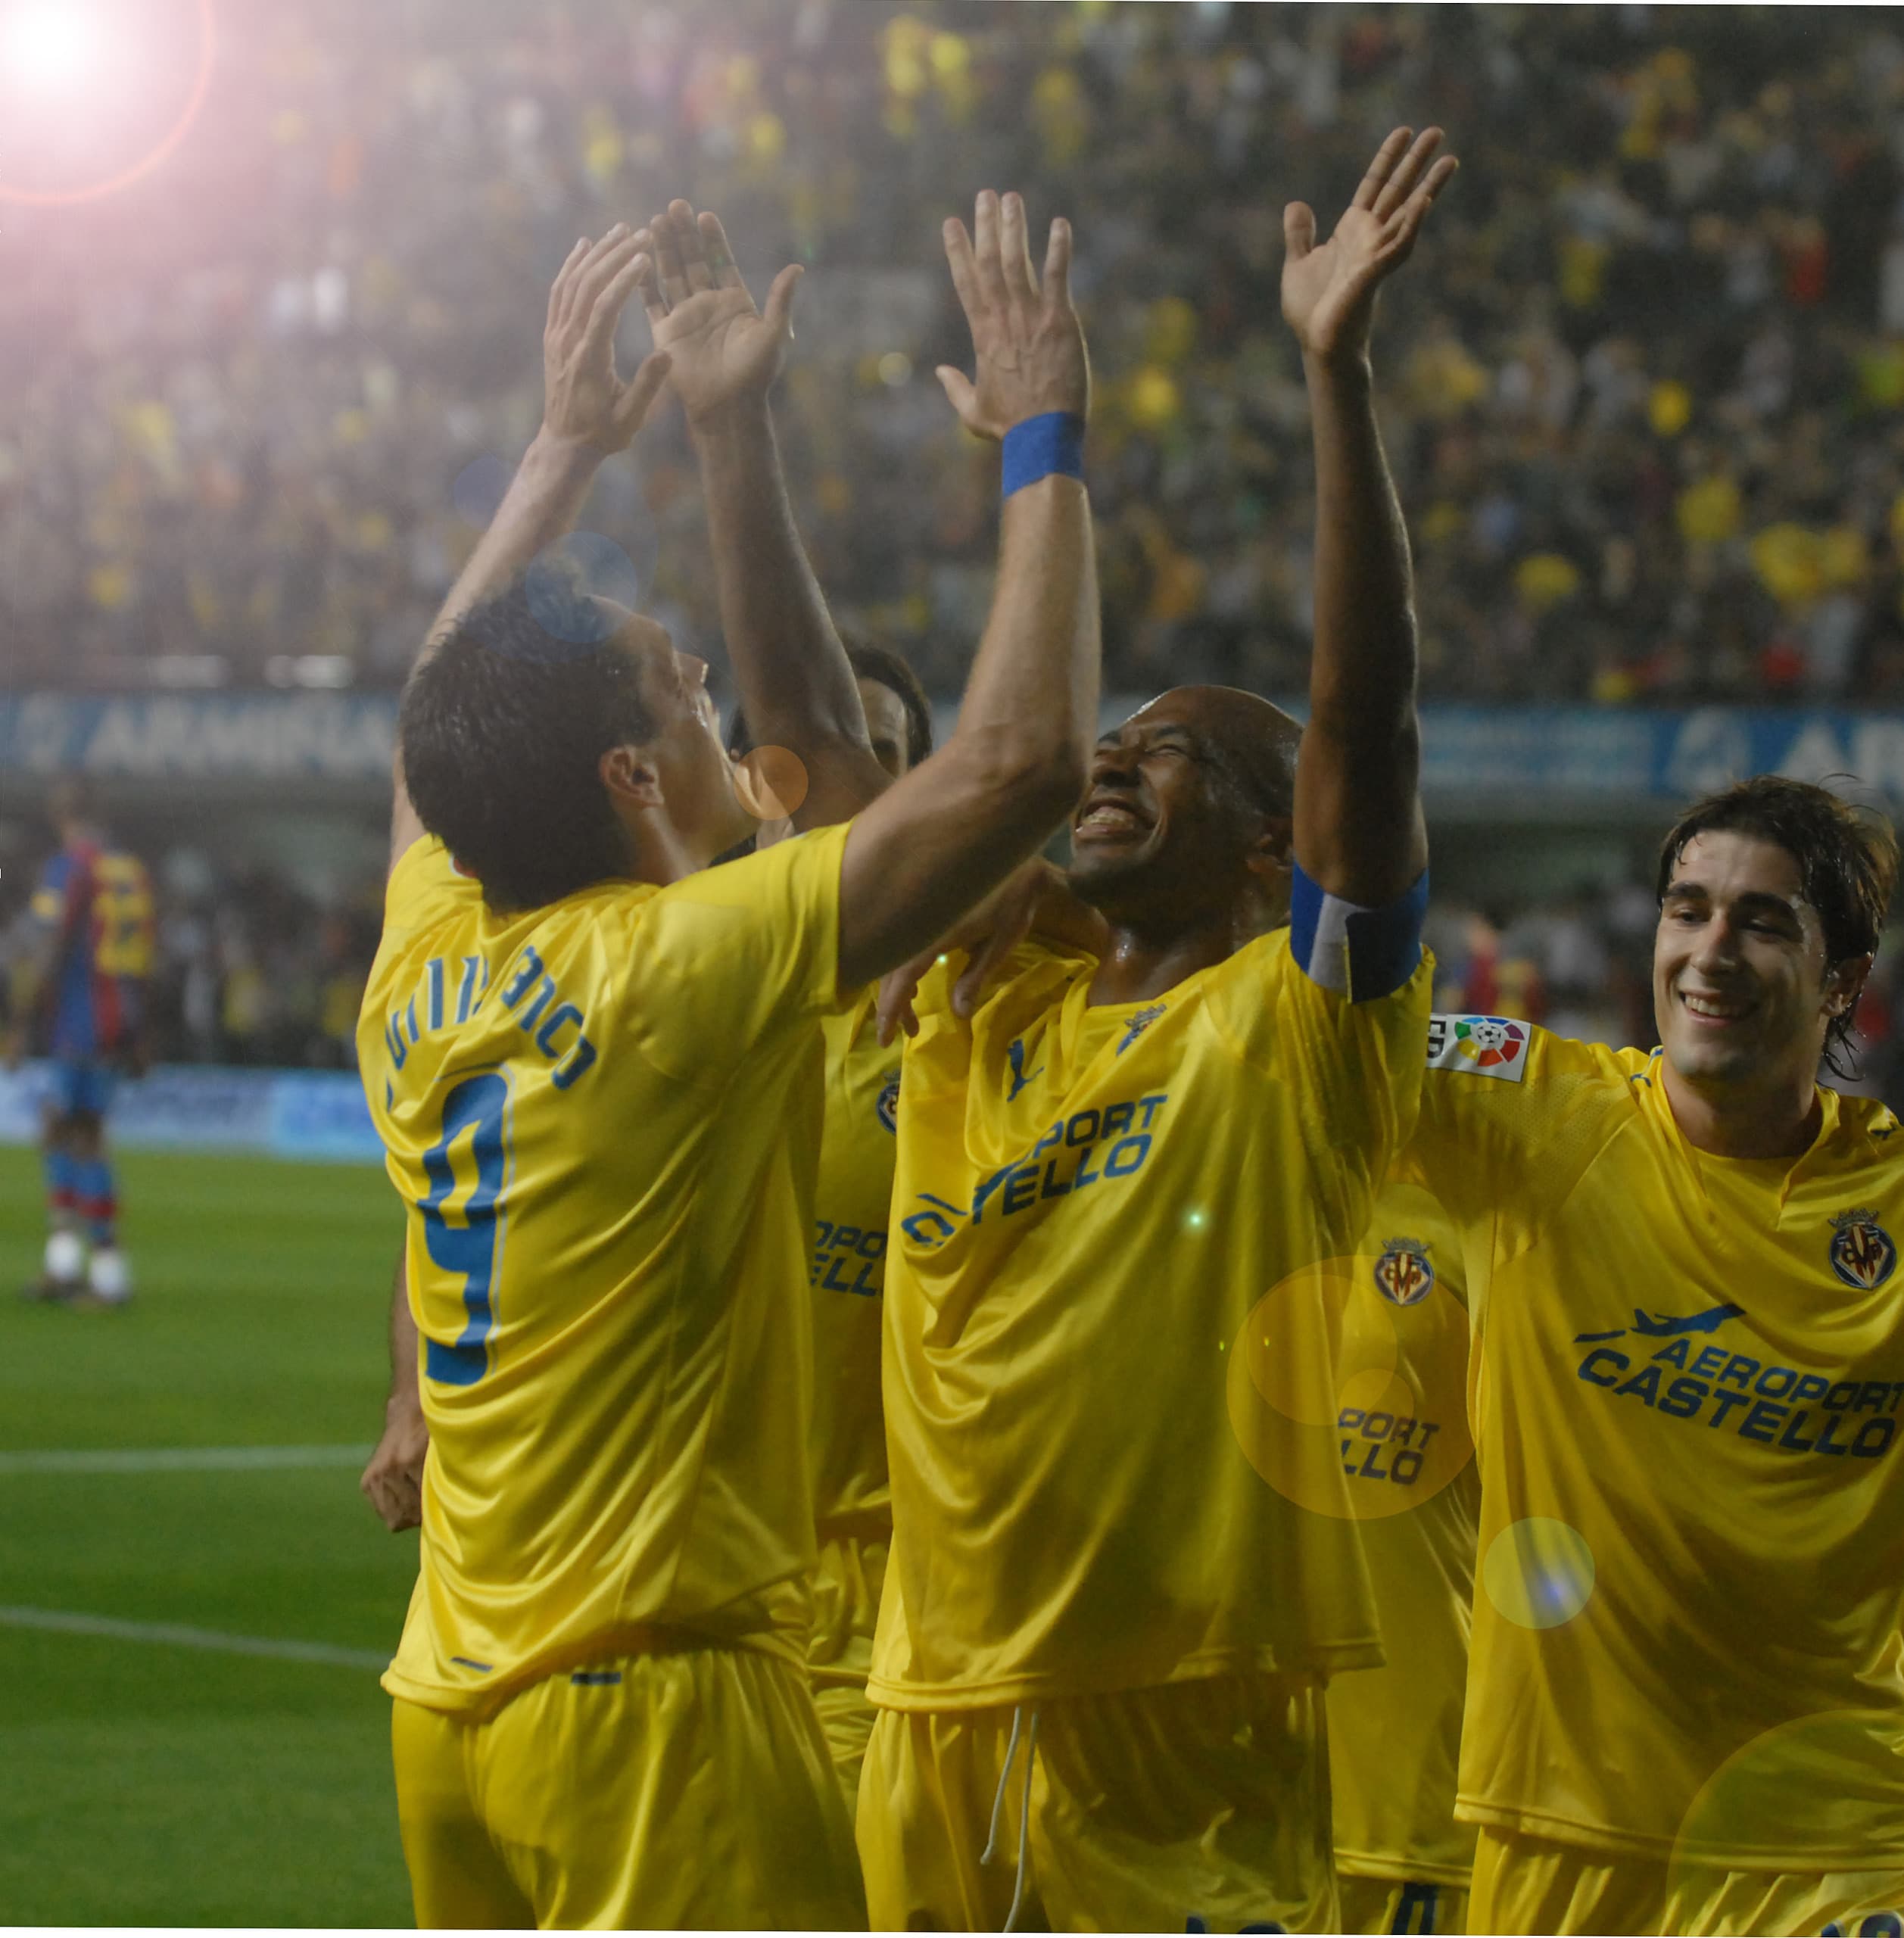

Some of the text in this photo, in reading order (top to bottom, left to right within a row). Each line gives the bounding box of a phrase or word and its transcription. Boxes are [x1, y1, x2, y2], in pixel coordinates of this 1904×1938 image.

[416, 1064, 513, 1386] 9
[1578, 1348, 1896, 1458] CASTELLO
[1652, 1338, 1904, 1413] AEROPORT
